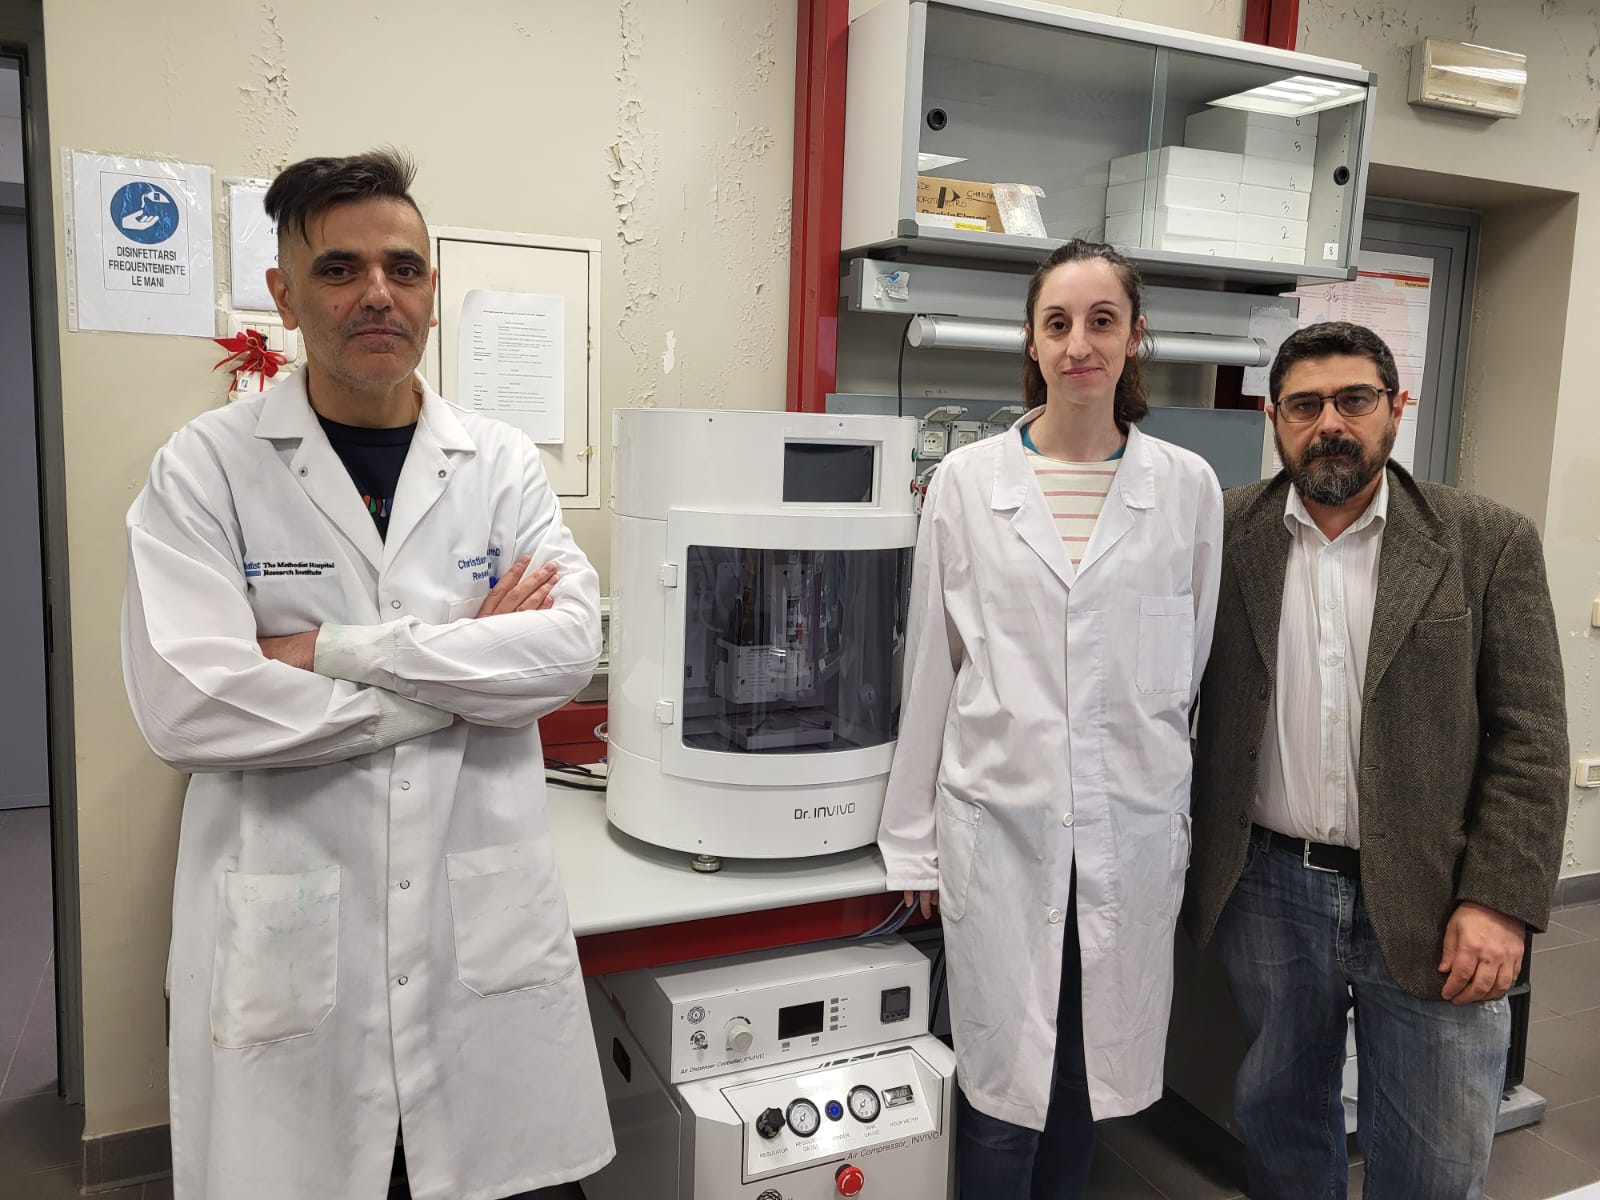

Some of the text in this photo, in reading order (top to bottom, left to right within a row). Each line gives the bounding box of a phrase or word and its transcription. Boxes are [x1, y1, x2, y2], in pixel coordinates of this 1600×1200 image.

[116, 246, 177, 261] DISINFETTARSI
[108, 259, 186, 276] FREQUENTEMENTE
[131, 275, 165, 288] LE MANI
[277, 561, 308, 569] Methodist
[309, 561, 335, 570] Hospital
[794, 802, 856, 820] Dr. INVIVO
[846, 1151, 859, 1161] Air
[911, 1131, 940, 1145] INVIVO
